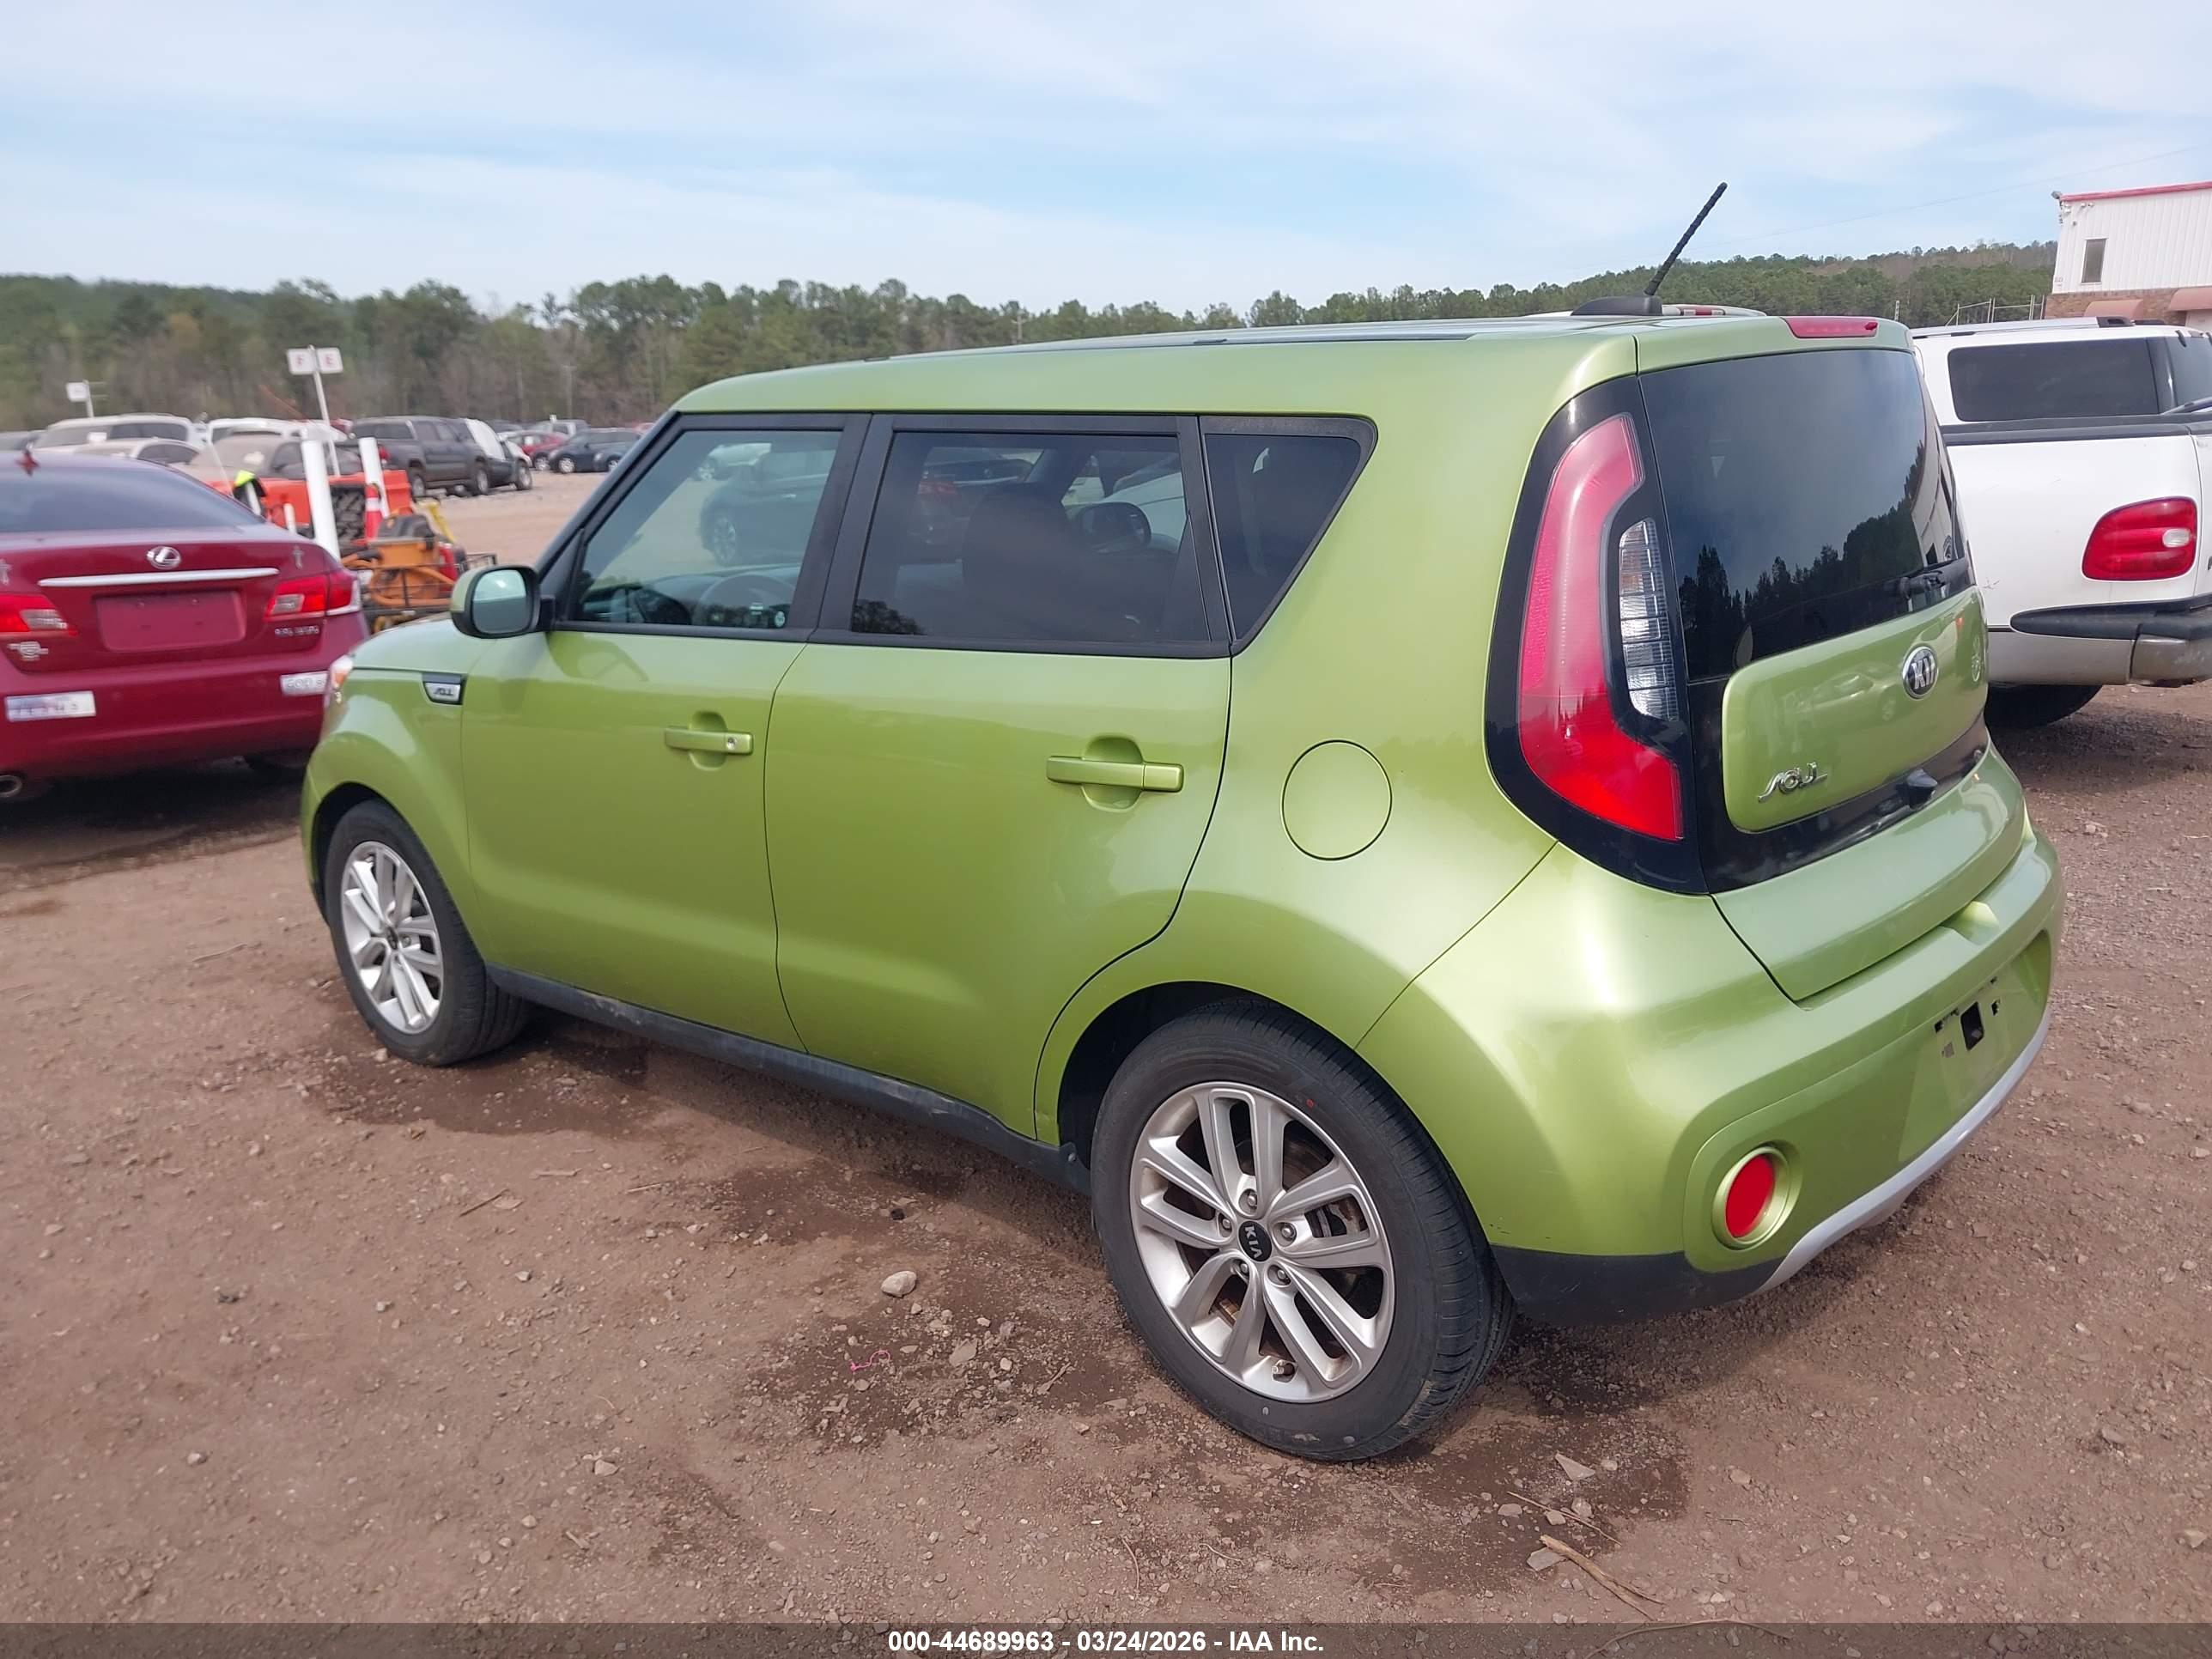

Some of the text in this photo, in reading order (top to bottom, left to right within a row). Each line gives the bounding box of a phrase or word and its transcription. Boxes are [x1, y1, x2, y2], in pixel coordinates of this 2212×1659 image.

[1911, 654, 1936, 690] KIA
[1757, 762, 1828, 803] SOUL
[1244, 1225, 1262, 1259] KIA
